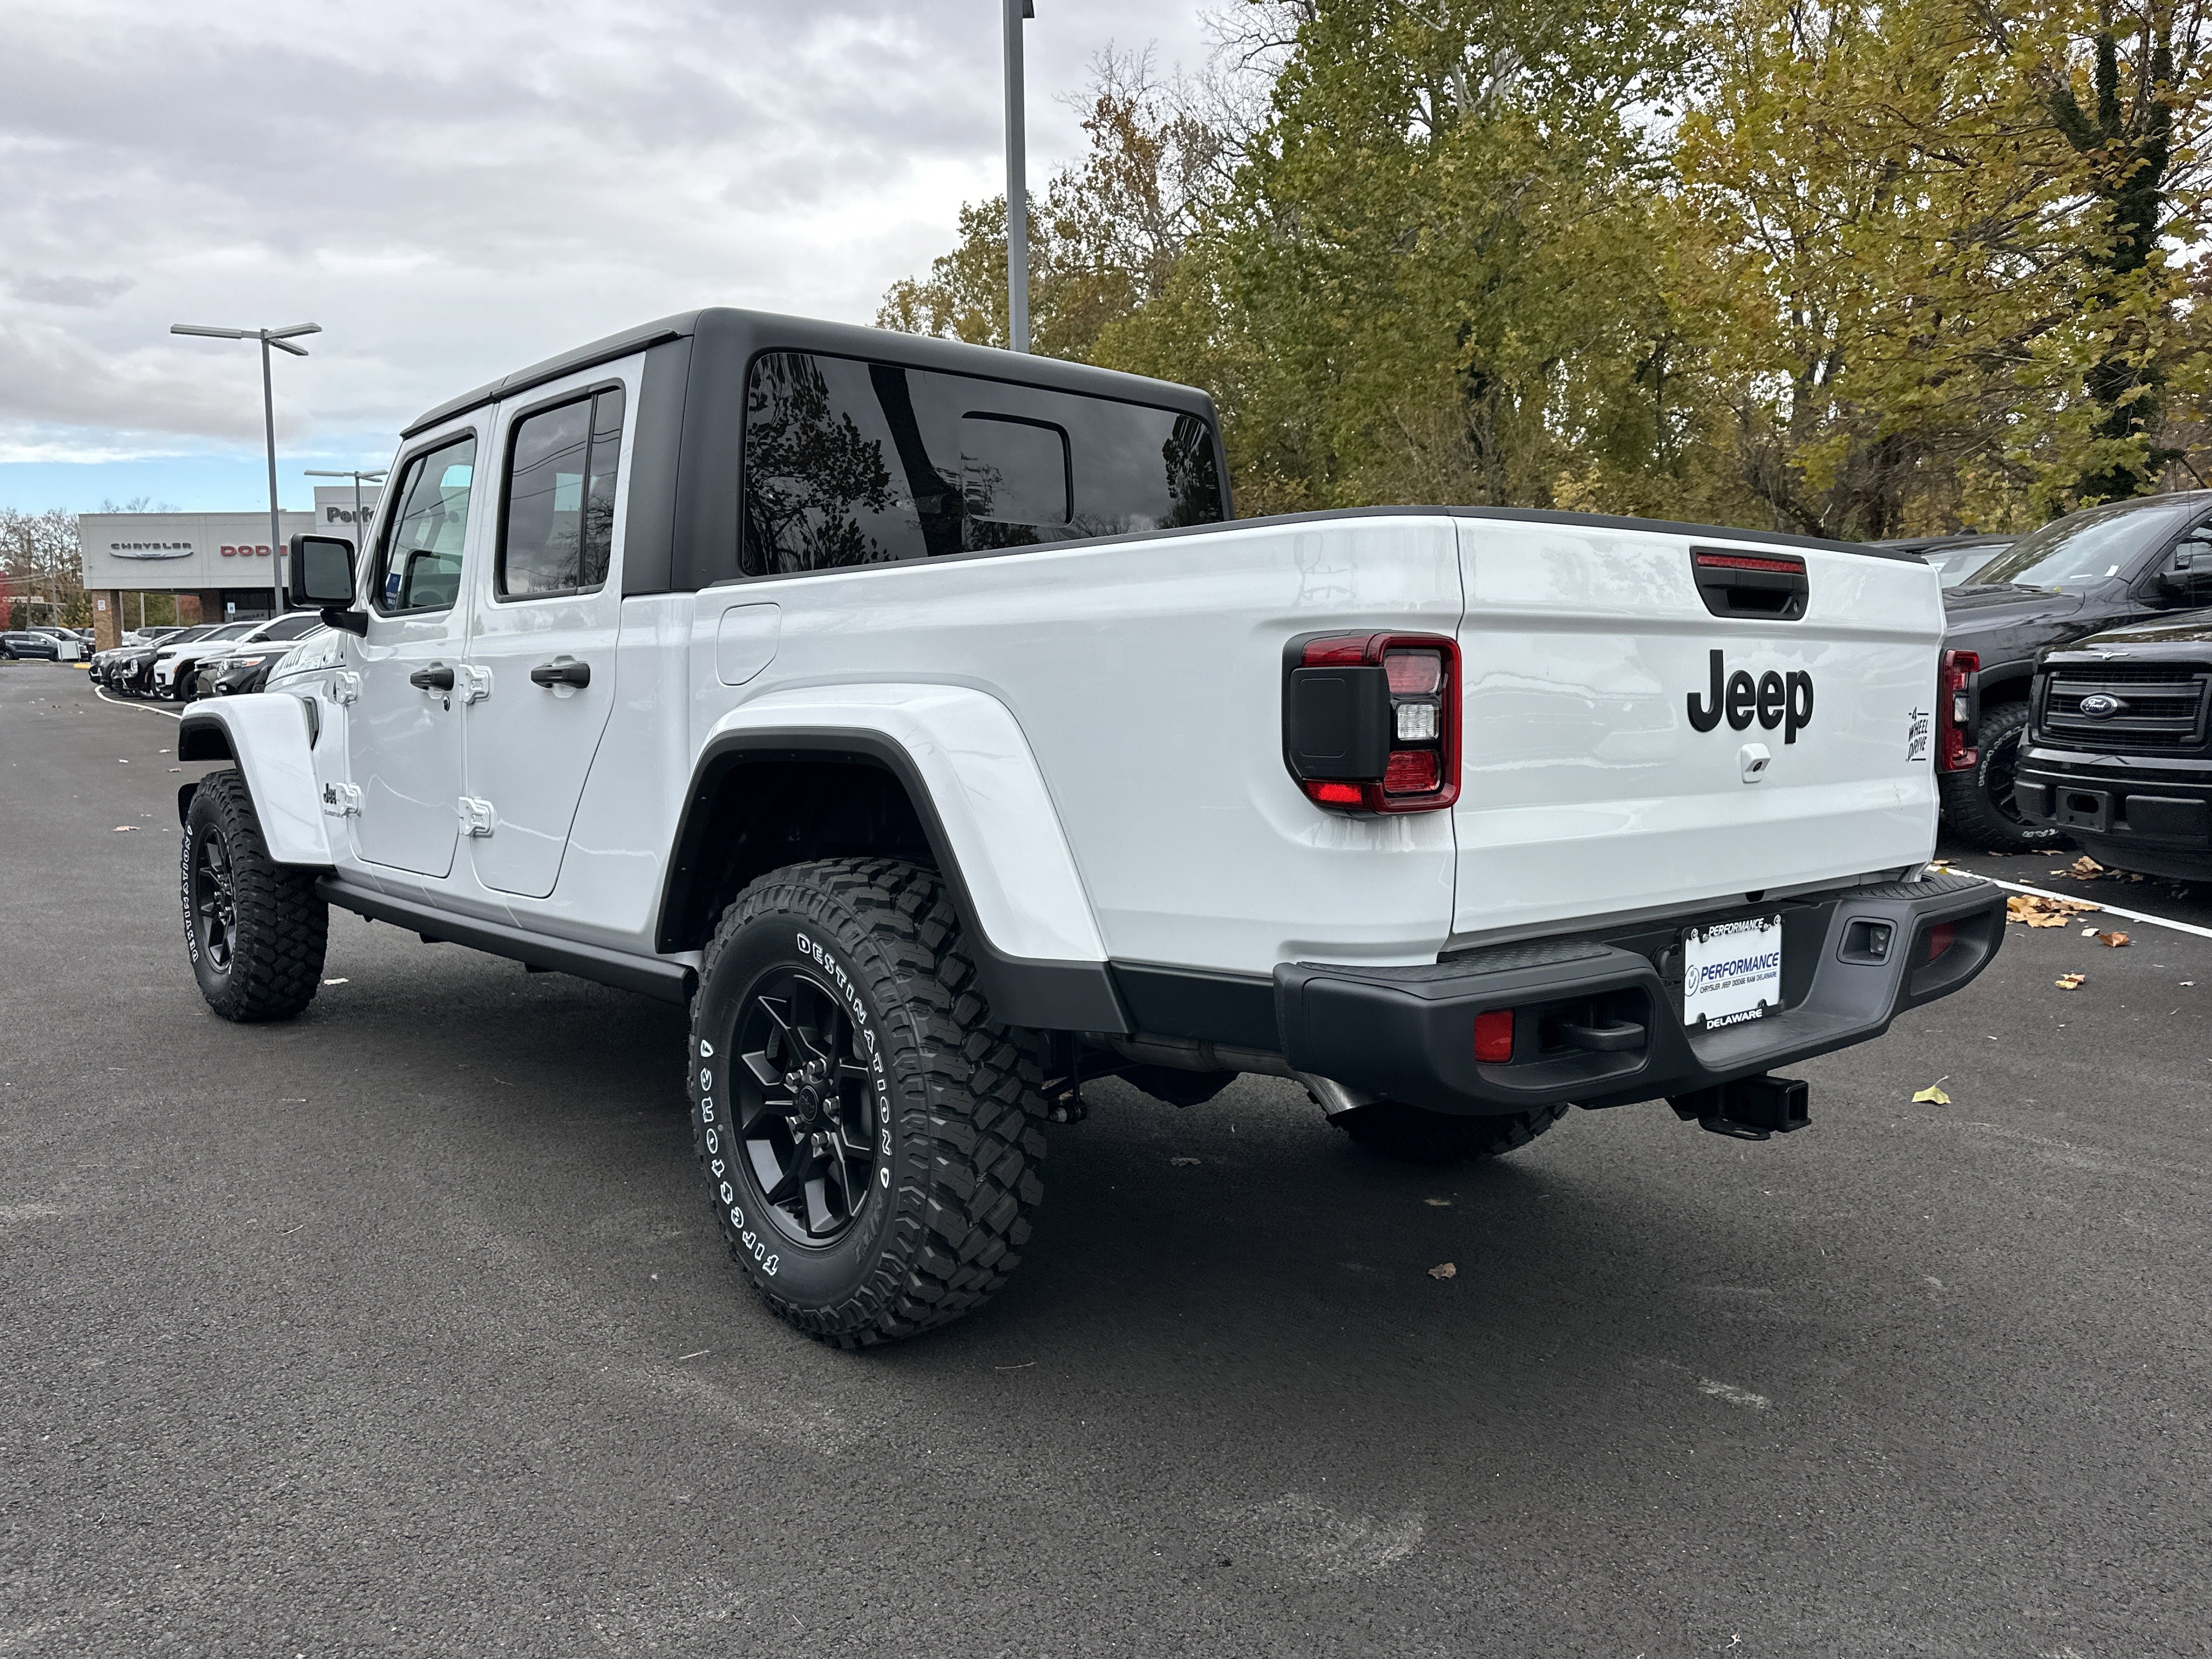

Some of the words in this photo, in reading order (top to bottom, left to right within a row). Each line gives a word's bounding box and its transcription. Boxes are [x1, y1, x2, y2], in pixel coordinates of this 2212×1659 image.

[1686, 649, 1813, 744] Jeep
[1909, 719, 1928, 742] WHEEL
[1907, 736, 1927, 762] DRIVE
[1708, 917, 1764, 936] PERFORMANCE
[1701, 952, 1779, 981] PERFORMANCE
[1700, 983, 1720, 994] CHRYSLER
[1720, 980, 1731, 989] JEEP
[1732, 978, 1746, 987] DODGE
[1747, 975, 1755, 984] RAM
[1756, 970, 1778, 981] DELAWARE
[1707, 1008, 1763, 1030] DELAWARE
[797, 933, 893, 1156] DESTINATION
